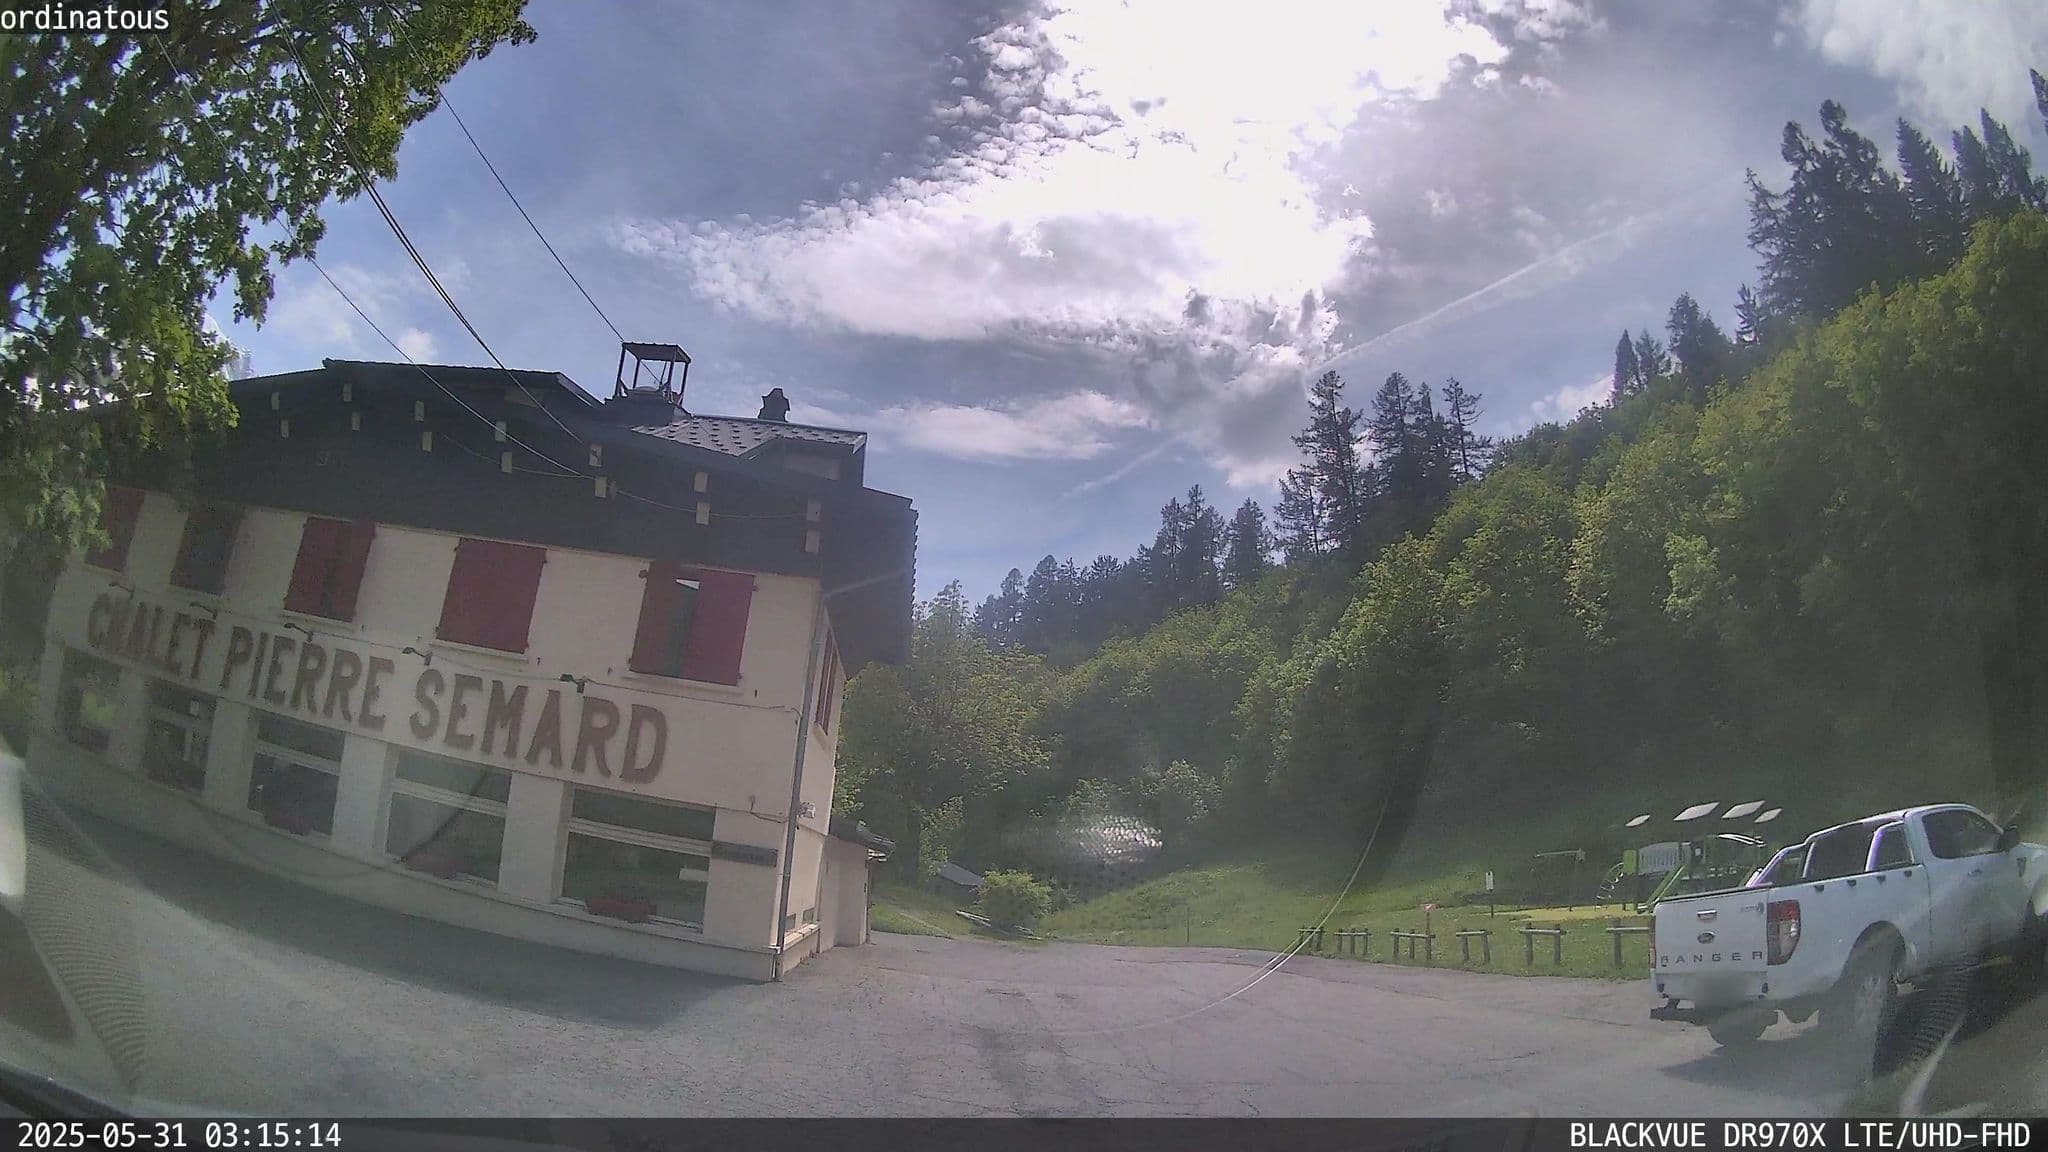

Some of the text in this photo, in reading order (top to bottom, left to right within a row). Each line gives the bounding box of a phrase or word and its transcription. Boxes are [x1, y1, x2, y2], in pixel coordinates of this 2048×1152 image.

[88, 592, 668, 785] CHALET PIERRE SEMARD
[1660, 951, 1763, 964] RANGER
